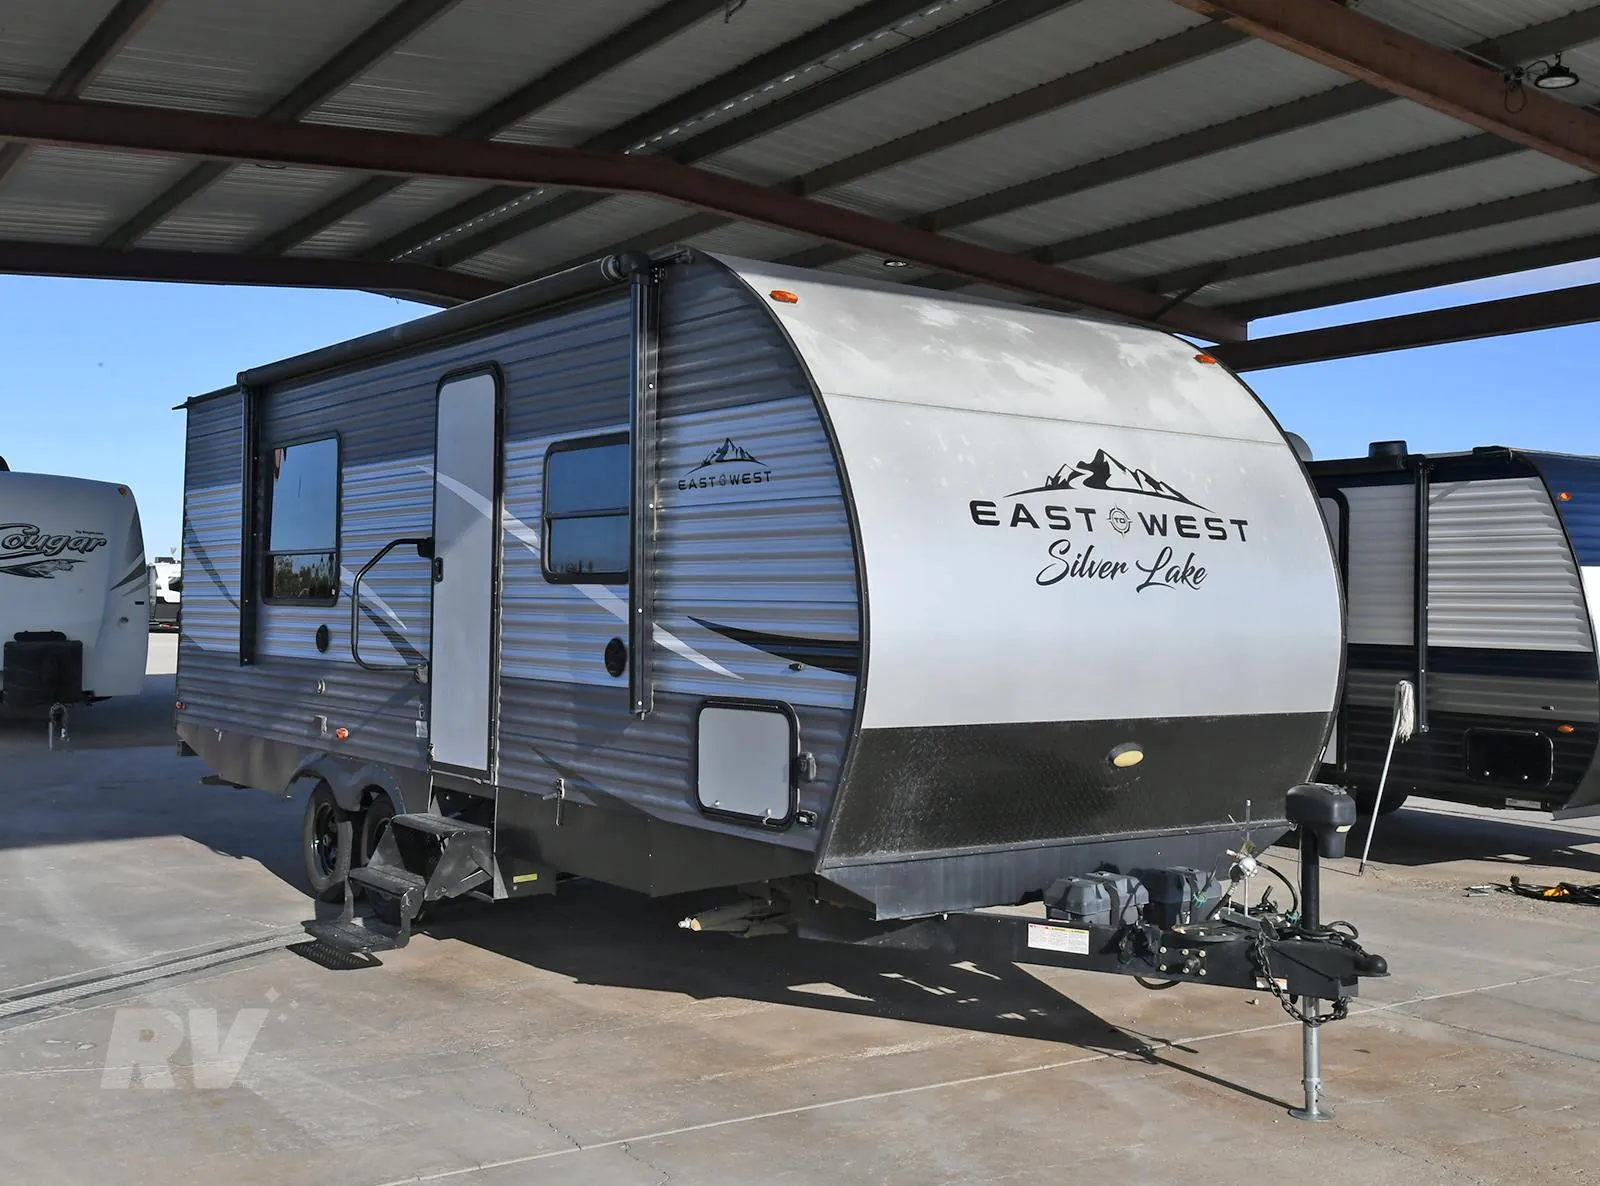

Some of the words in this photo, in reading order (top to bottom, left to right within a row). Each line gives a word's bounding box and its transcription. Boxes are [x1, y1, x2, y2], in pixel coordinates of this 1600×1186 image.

[678, 476, 716, 491] EAST
[729, 471, 772, 486] WEST
[969, 500, 1097, 532] EAST
[1137, 511, 1249, 542] WEST
[1035, 538, 1129, 586] Silver
[1135, 546, 1208, 593] Lake
